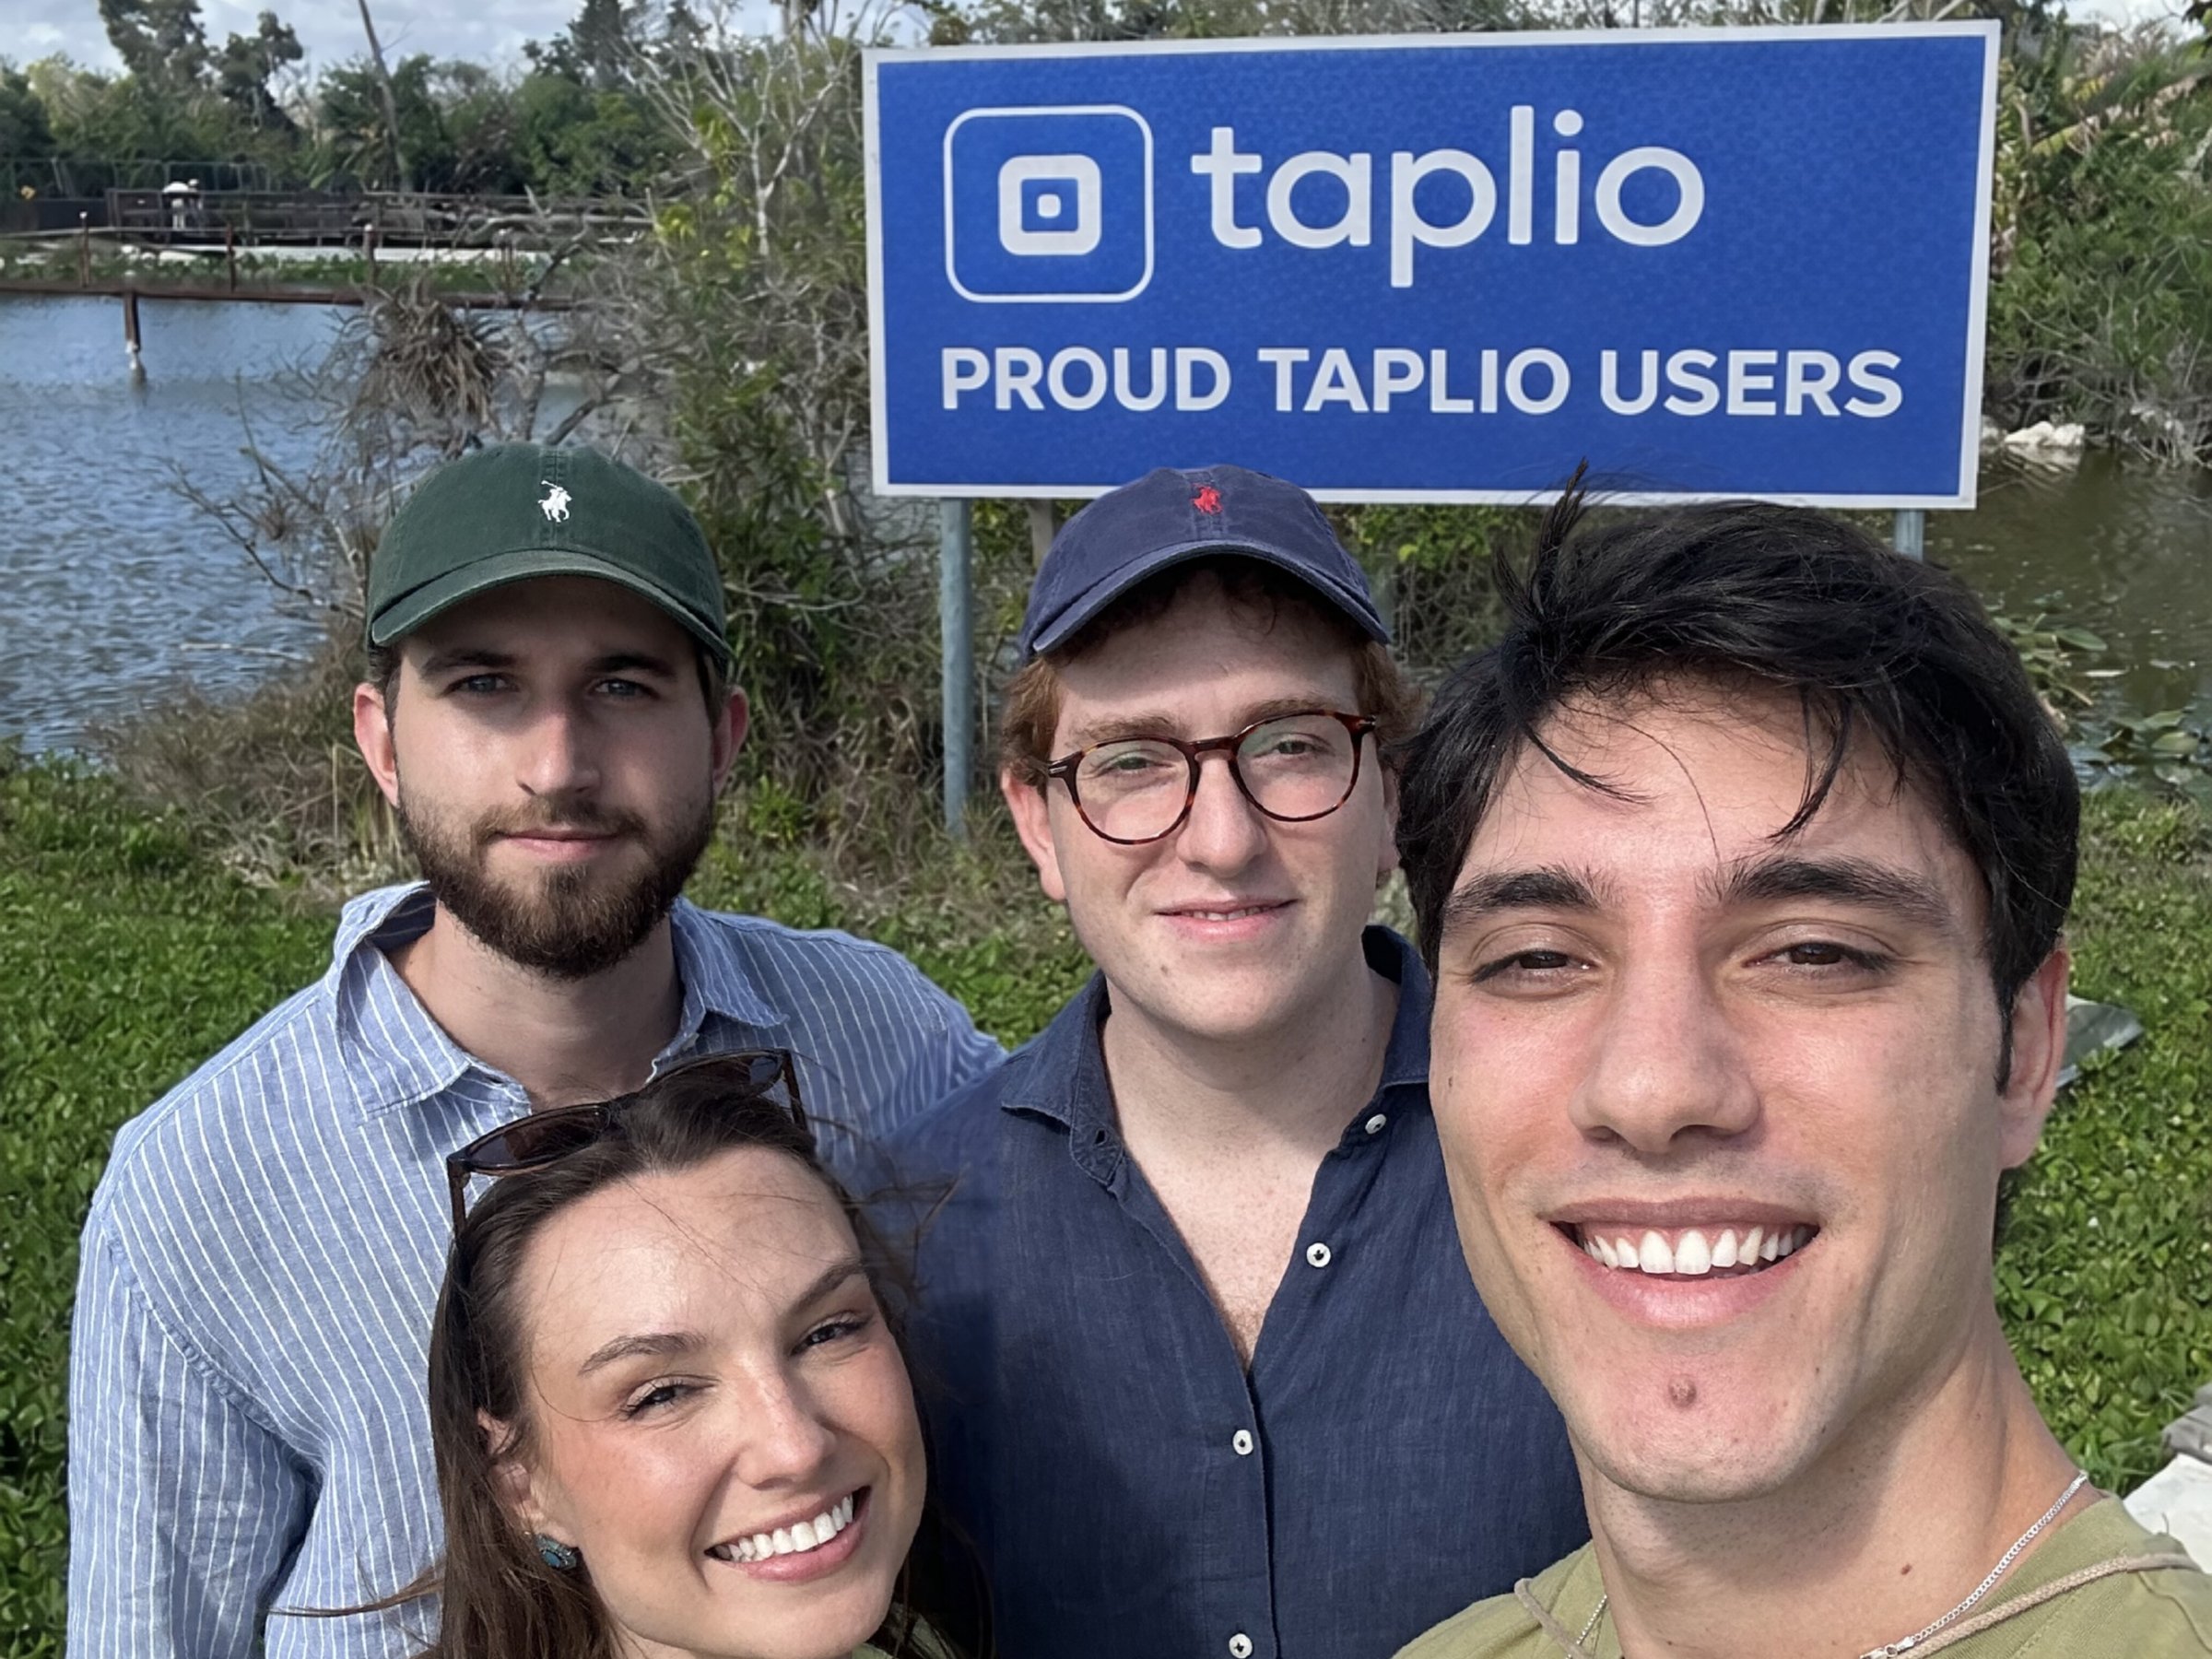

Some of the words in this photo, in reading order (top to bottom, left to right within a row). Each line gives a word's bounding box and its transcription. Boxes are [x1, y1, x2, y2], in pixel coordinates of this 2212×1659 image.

[1191, 105, 1704, 288] taplio
[942, 347, 1230, 412] PROUD
[1258, 348, 1570, 415] TAPLIO
[1600, 350, 1902, 418] USERS
